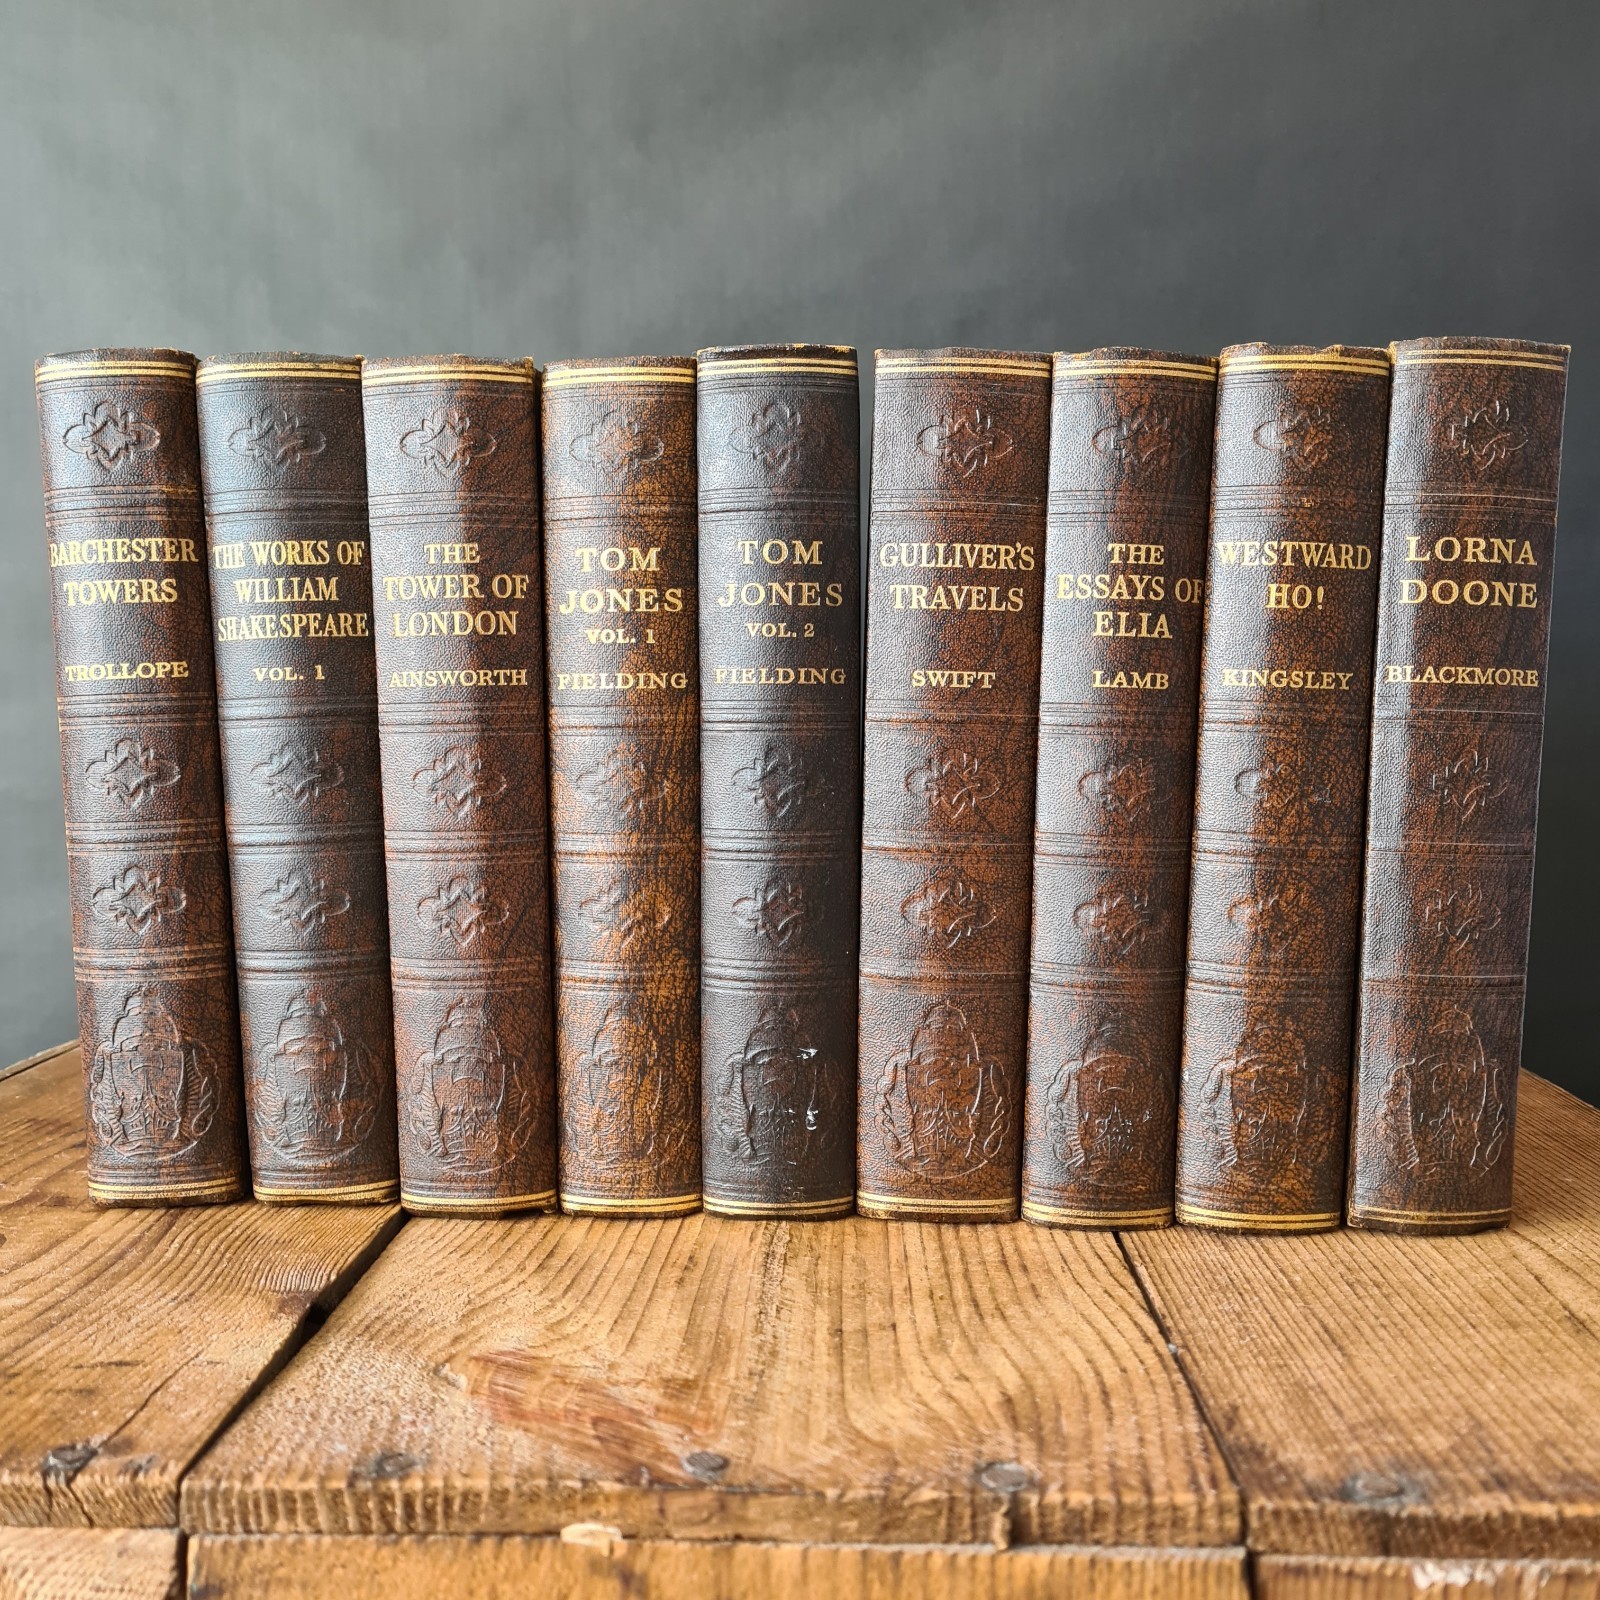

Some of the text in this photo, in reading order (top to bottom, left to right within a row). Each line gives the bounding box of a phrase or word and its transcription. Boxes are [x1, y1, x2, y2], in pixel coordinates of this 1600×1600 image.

[49, 538, 199, 568] BARCHESTER
[212, 540, 364, 570] THE WORKS OF
[423, 543, 481, 564] THE
[576, 546, 661, 573] TOM
[737, 540, 823, 566] TOM
[880, 541, 1035, 570] GULLIVER'S
[1107, 544, 1164, 565] THE
[1217, 541, 1371, 570] WESTWARD
[1404, 536, 1537, 567] LORNA
[63, 578, 178, 607] TOWERS
[235, 576, 339, 603] WILLIAM
[383, 574, 529, 600] TOWER OF
[718, 582, 843, 608] JONES
[889, 584, 1024, 612] TRAVELS
[1057, 574, 1203, 603] ESSAYS OF
[1265, 584, 1325, 610] HO!
[1399, 579, 1537, 608] DOONE
[559, 587, 683, 614] JONES
[218, 612, 368, 642] SHAKESPEARE
[393, 610, 517, 637] LONDON
[747, 622, 814, 638] VOL. 2
[1093, 611, 1173, 639] ELIA
[585, 629, 655, 645] VOL. 1
[65, 661, 189, 681] TROLLOPE
[252, 665, 324, 682] VOL. 1
[389, 668, 527, 688] AINSWORTH
[557, 672, 689, 691] FIELDING
[715, 667, 846, 686] FIELDING
[911, 670, 996, 689] SWIFT
[1093, 670, 1169, 690] LAMB
[1222, 669, 1353, 691] KINGSLEY
[1385, 665, 1539, 688] BLACKMORE
